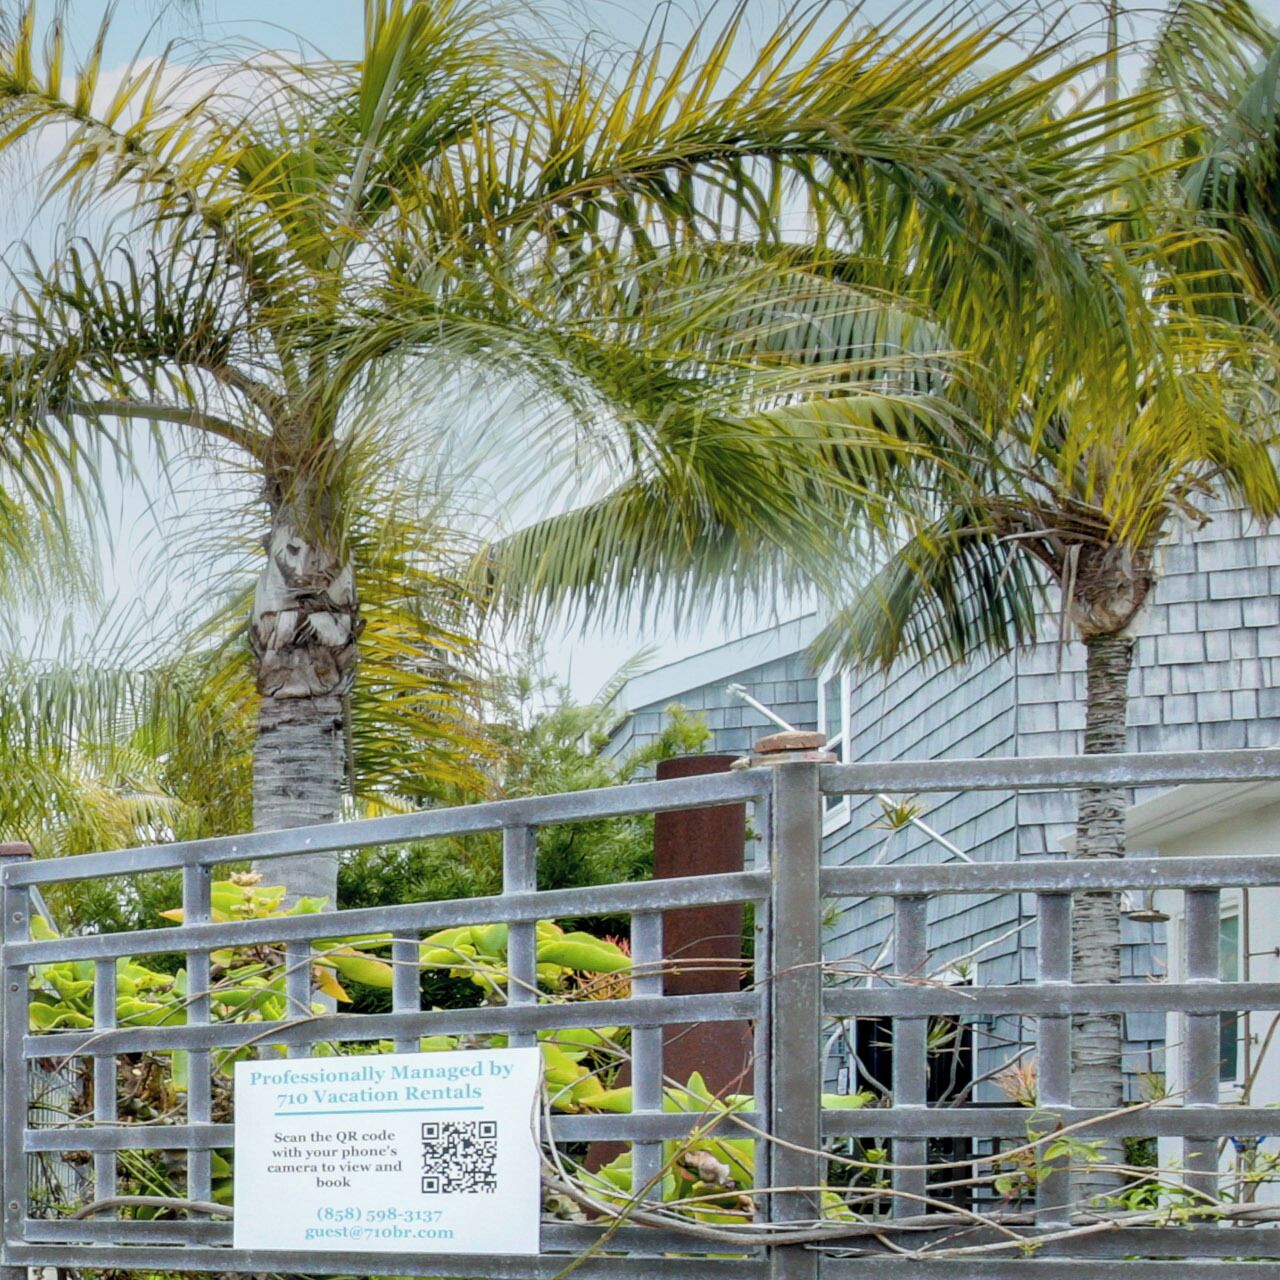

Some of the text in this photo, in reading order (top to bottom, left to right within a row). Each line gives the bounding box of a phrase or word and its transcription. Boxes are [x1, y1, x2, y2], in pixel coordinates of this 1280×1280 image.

[250, 1060, 514, 1085] Professionally Managed by
[276, 1083, 482, 1108] 710 Vacation Rentals
[273, 1129, 396, 1144] Scan the QR code
[272, 1145, 398, 1160] with your phone's
[267, 1160, 403, 1173] camera to view and
[316, 1176, 351, 1188] book
[317, 1206, 444, 1223] (858) 598-3137
[304, 1224, 455, 1241] guest@710br.com
